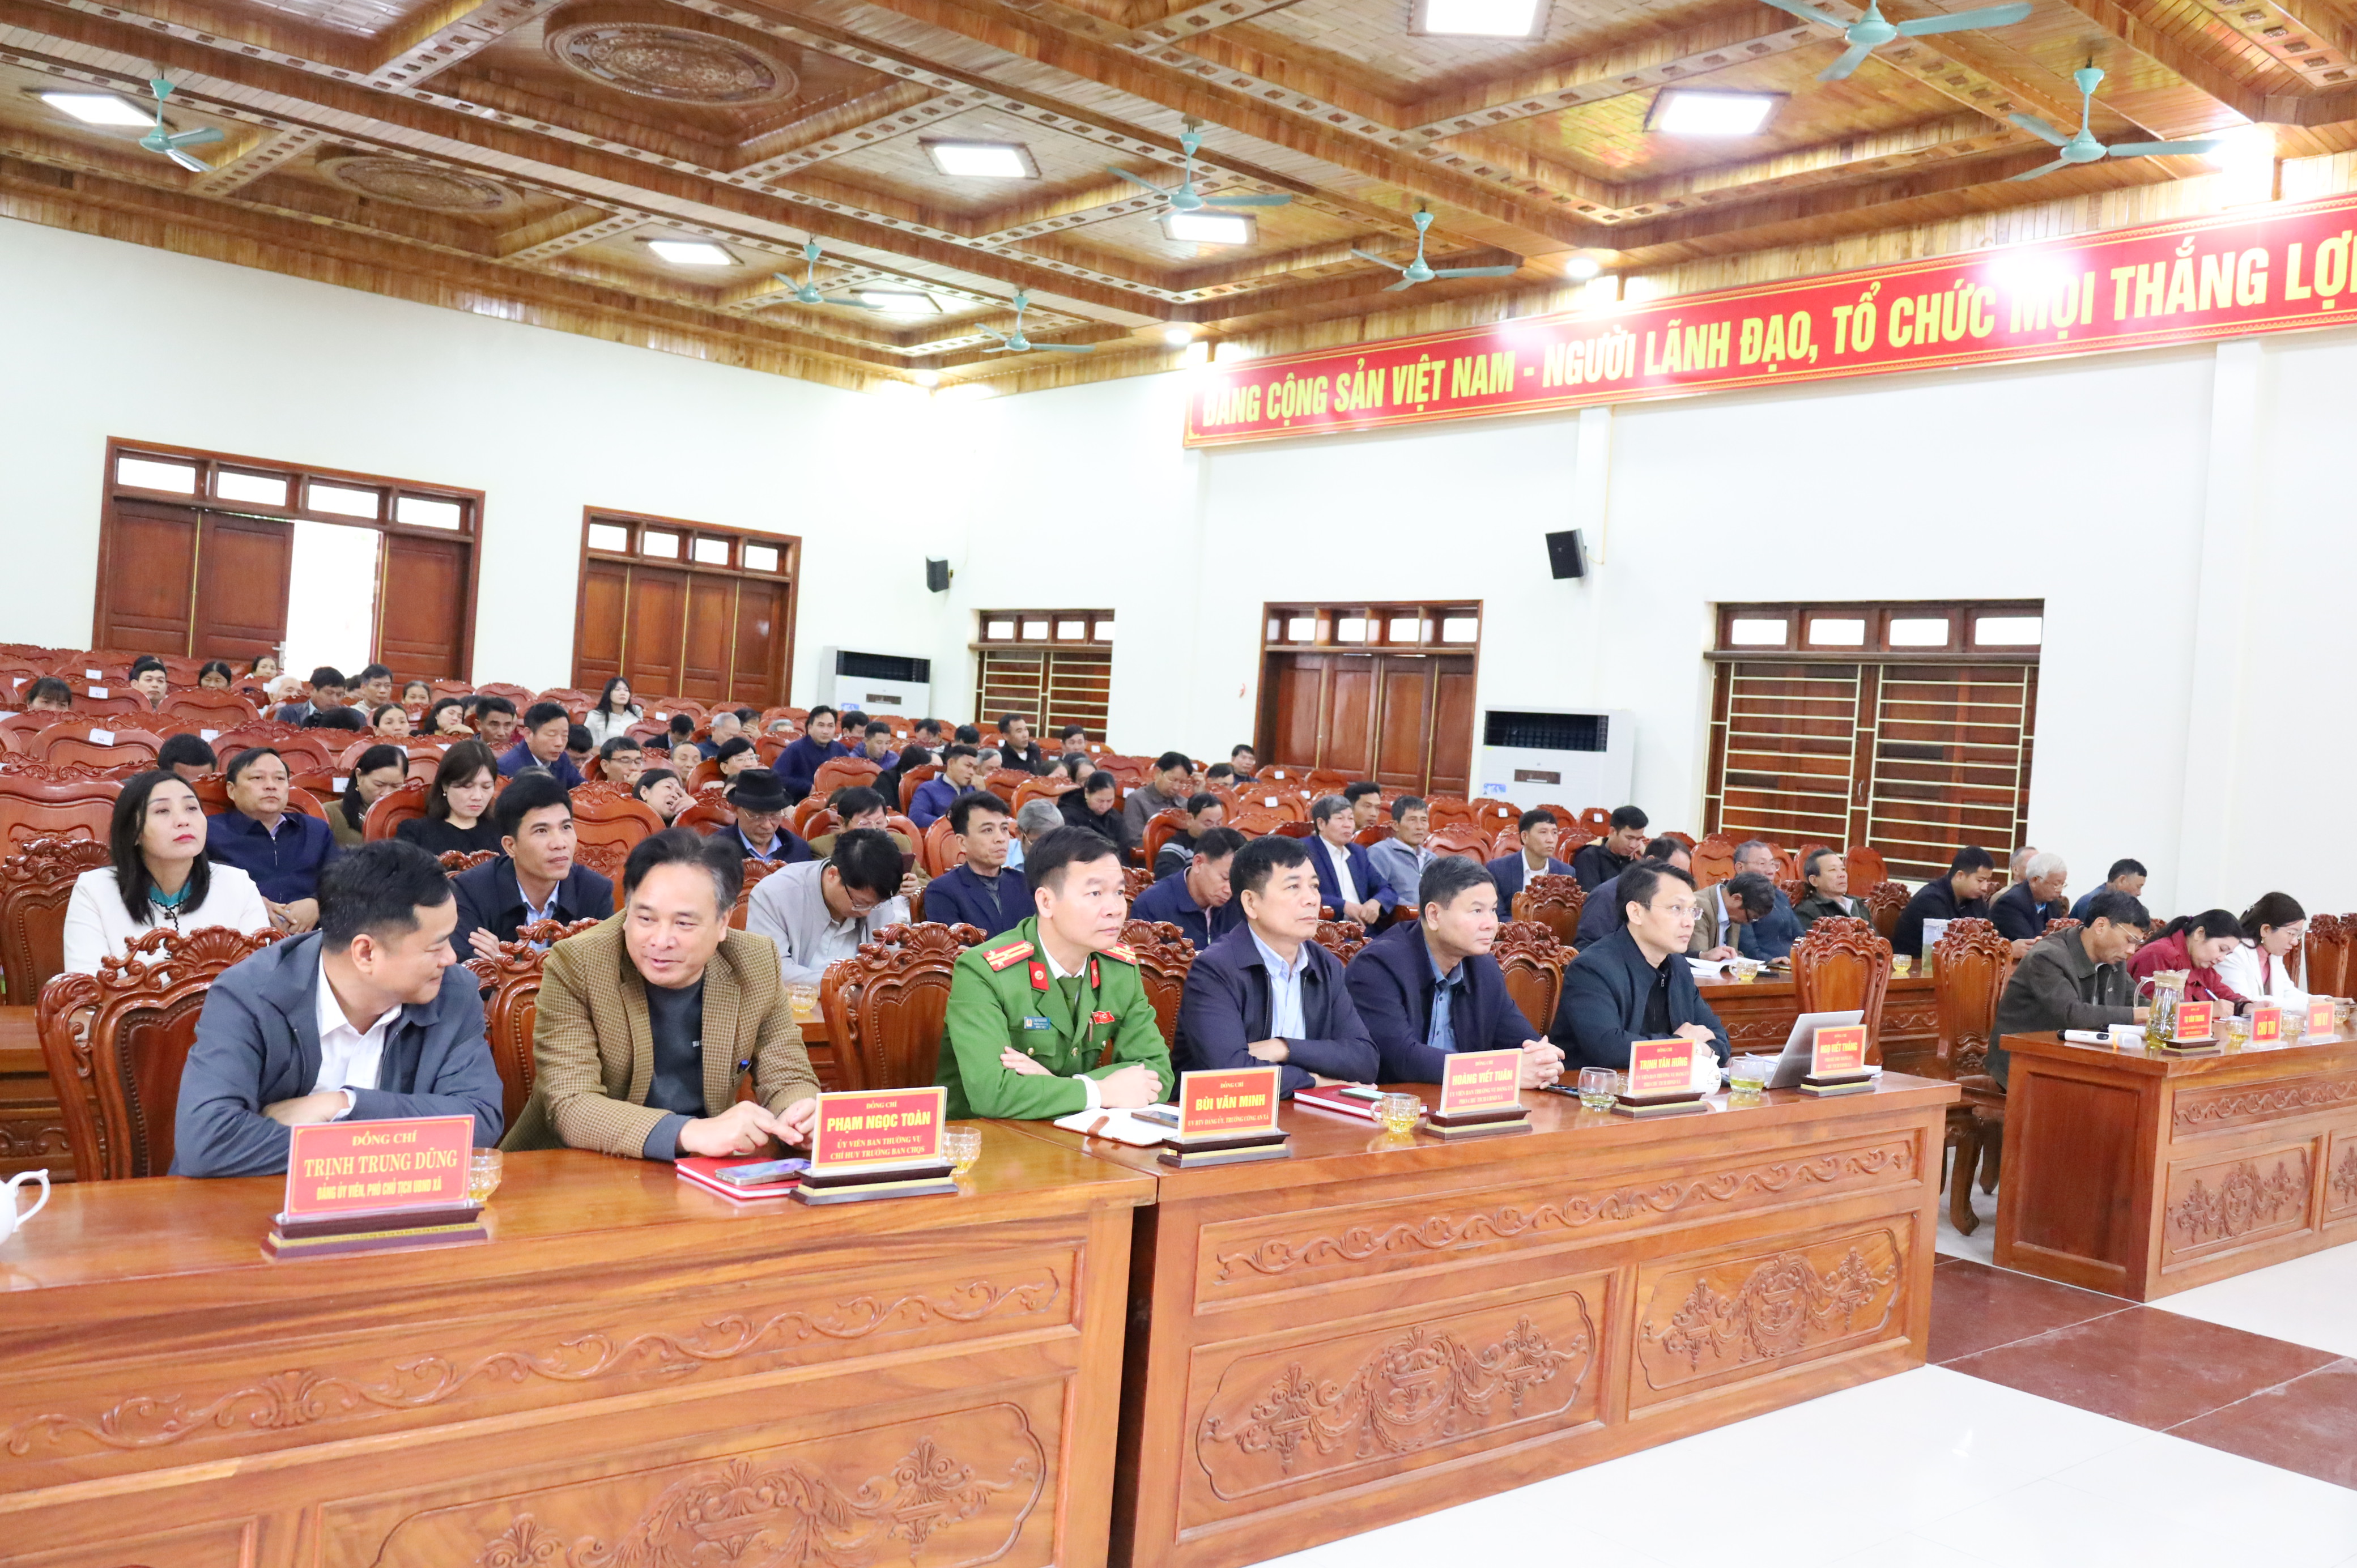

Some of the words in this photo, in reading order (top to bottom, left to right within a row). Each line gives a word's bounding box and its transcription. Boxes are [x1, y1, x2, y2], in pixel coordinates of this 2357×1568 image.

[1266, 371, 1327, 427] CỘNG
[1335, 357, 1384, 412] SẢN
[1391, 353, 1445, 411] VIỆT
[1451, 350, 1515, 399] NAM
[1542, 325, 1635, 387] NGƯỜI
[1644, 318, 1728, 376] LÃNH
[1739, 310, 1818, 372] ĐẠO,
[1832, 280, 1882, 353] TỔ
[1888, 278, 1996, 346] CHỨC
[2010, 271, 2096, 340] MỌI
[2111, 236, 2269, 321] THẮNG
[1640, 1059, 1657, 1071] TRỊNH
[1658, 1056, 1671, 1068] VĂN
[1452, 1072, 1477, 1086] HOÀNG
[1478, 1068, 1494, 1083] VIẾT
[1195, 1096, 1214, 1111] BÙI
[1216, 1094, 1237, 1109] VĂN
[1239, 1094, 1266, 1107] MINH
[827, 1116, 863, 1133] PHẠM
[866, 1113, 898, 1131] NGỌC
[901, 1109, 930, 1126] TOÀN
[393, 1130, 417, 1144] CHÍ
[845, 1151, 861, 1159] HUY
[907, 1145, 925, 1154] CHQS
[304, 1156, 355, 1181] TRỊNH
[358, 1152, 411, 1174] TRUNG
[415, 1147, 457, 1169] DŨNG
[367, 1177, 381, 1196] PHÓ
[382, 1175, 396, 1195] CHỦ
[397, 1180, 412, 1196] TỊCH
[412, 1178, 432, 1193] UBND
